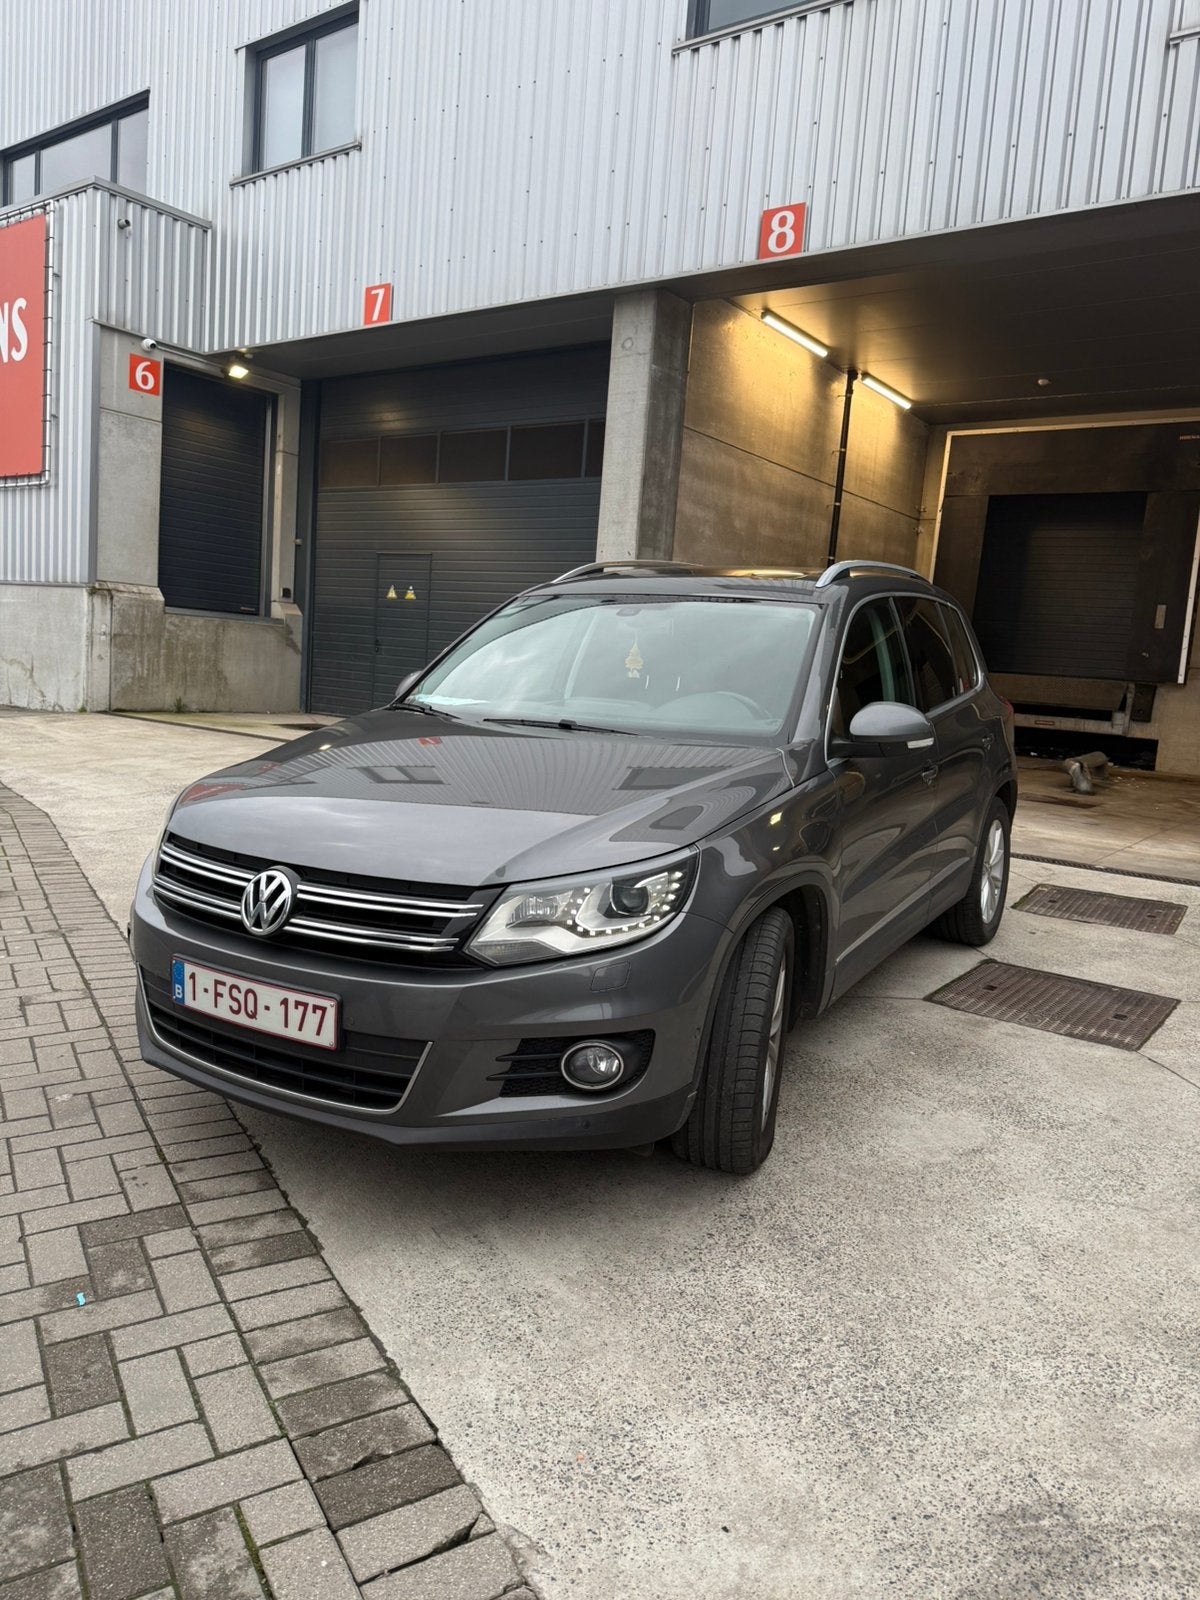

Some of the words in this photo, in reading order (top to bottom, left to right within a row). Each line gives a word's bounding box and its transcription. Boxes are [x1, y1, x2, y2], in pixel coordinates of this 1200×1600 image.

[768, 211, 795, 254] 8
[371, 288, 385, 321] 7
[135, 361, 154, 390] 6
[175, 984, 183, 998] B
[189, 971, 328, 1036] 1-FSQ-177
